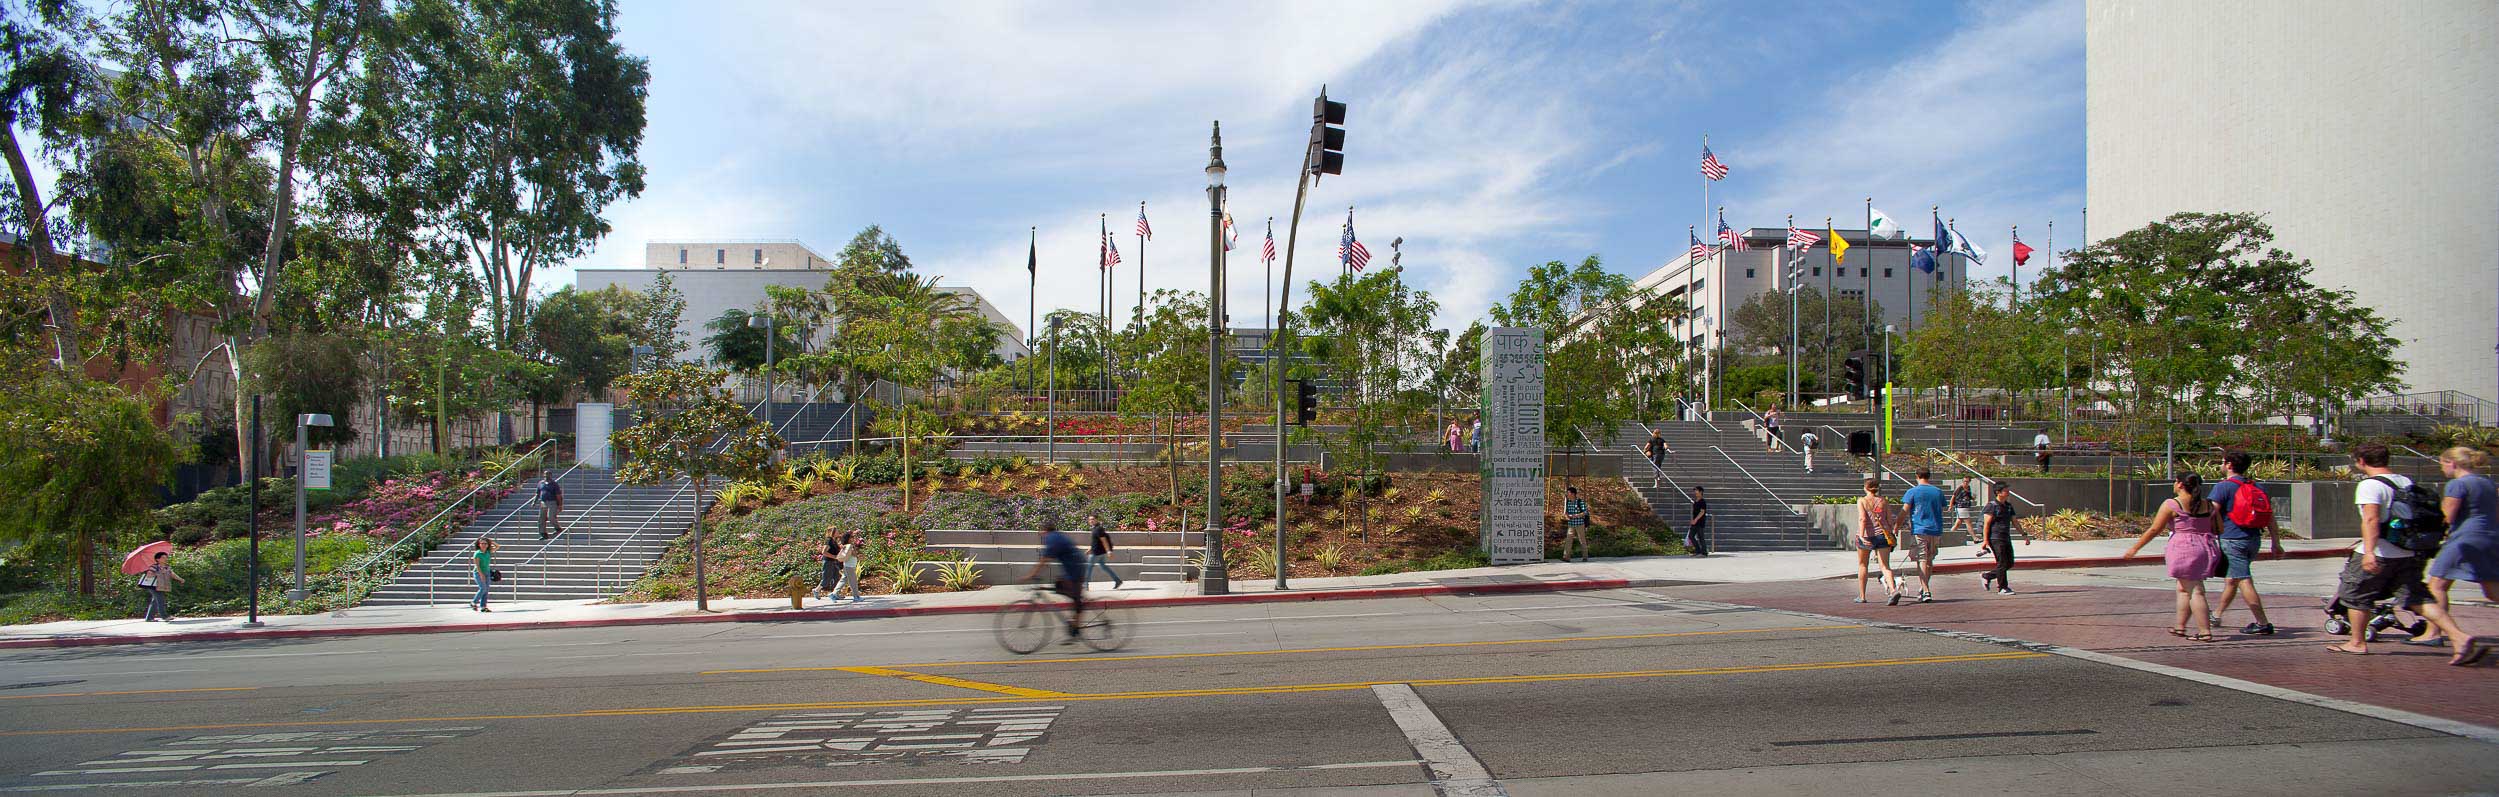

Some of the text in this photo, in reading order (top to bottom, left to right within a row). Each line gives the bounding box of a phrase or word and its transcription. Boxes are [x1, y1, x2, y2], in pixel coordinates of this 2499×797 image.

[1517, 392, 1543, 403] pour
[1517, 402, 1543, 434] tous
[1517, 441, 1542, 449] PARK
